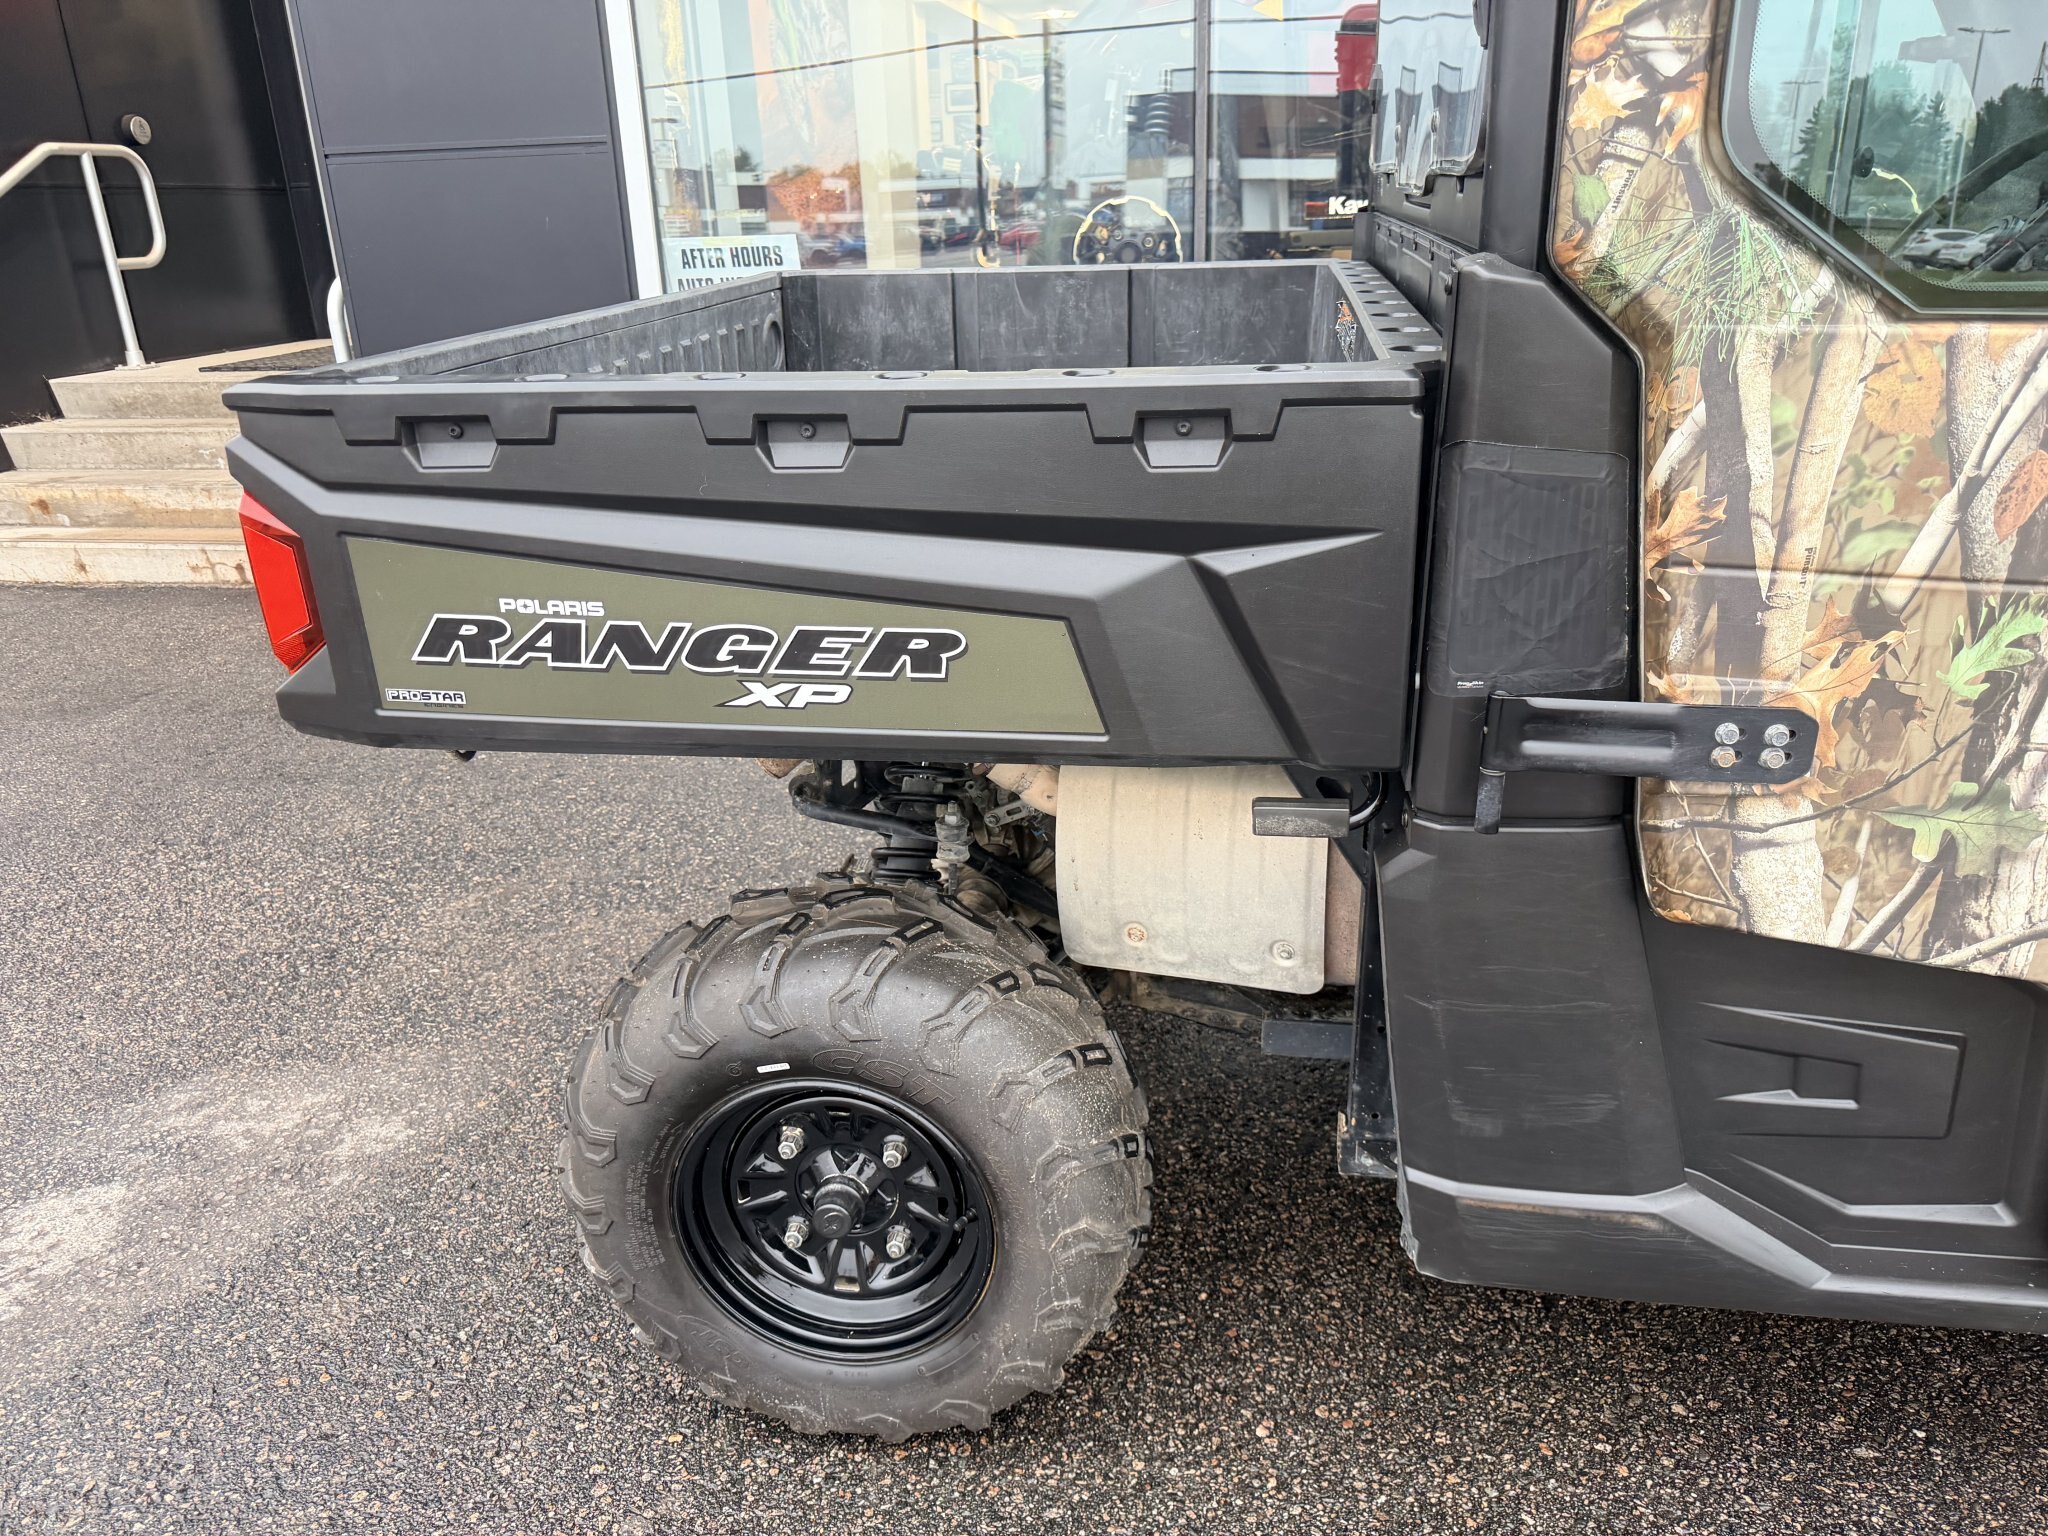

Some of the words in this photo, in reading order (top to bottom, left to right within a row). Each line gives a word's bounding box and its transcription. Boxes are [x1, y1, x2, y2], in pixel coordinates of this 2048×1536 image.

[681, 247, 726, 269] AFTER
[729, 245, 784, 268] HOURS
[498, 598, 605, 617] POLARIS
[412, 614, 968, 681] RANGER
[387, 688, 466, 704] PROSTAR
[713, 680, 854, 709] XP
[812, 1048, 957, 1106] CST
